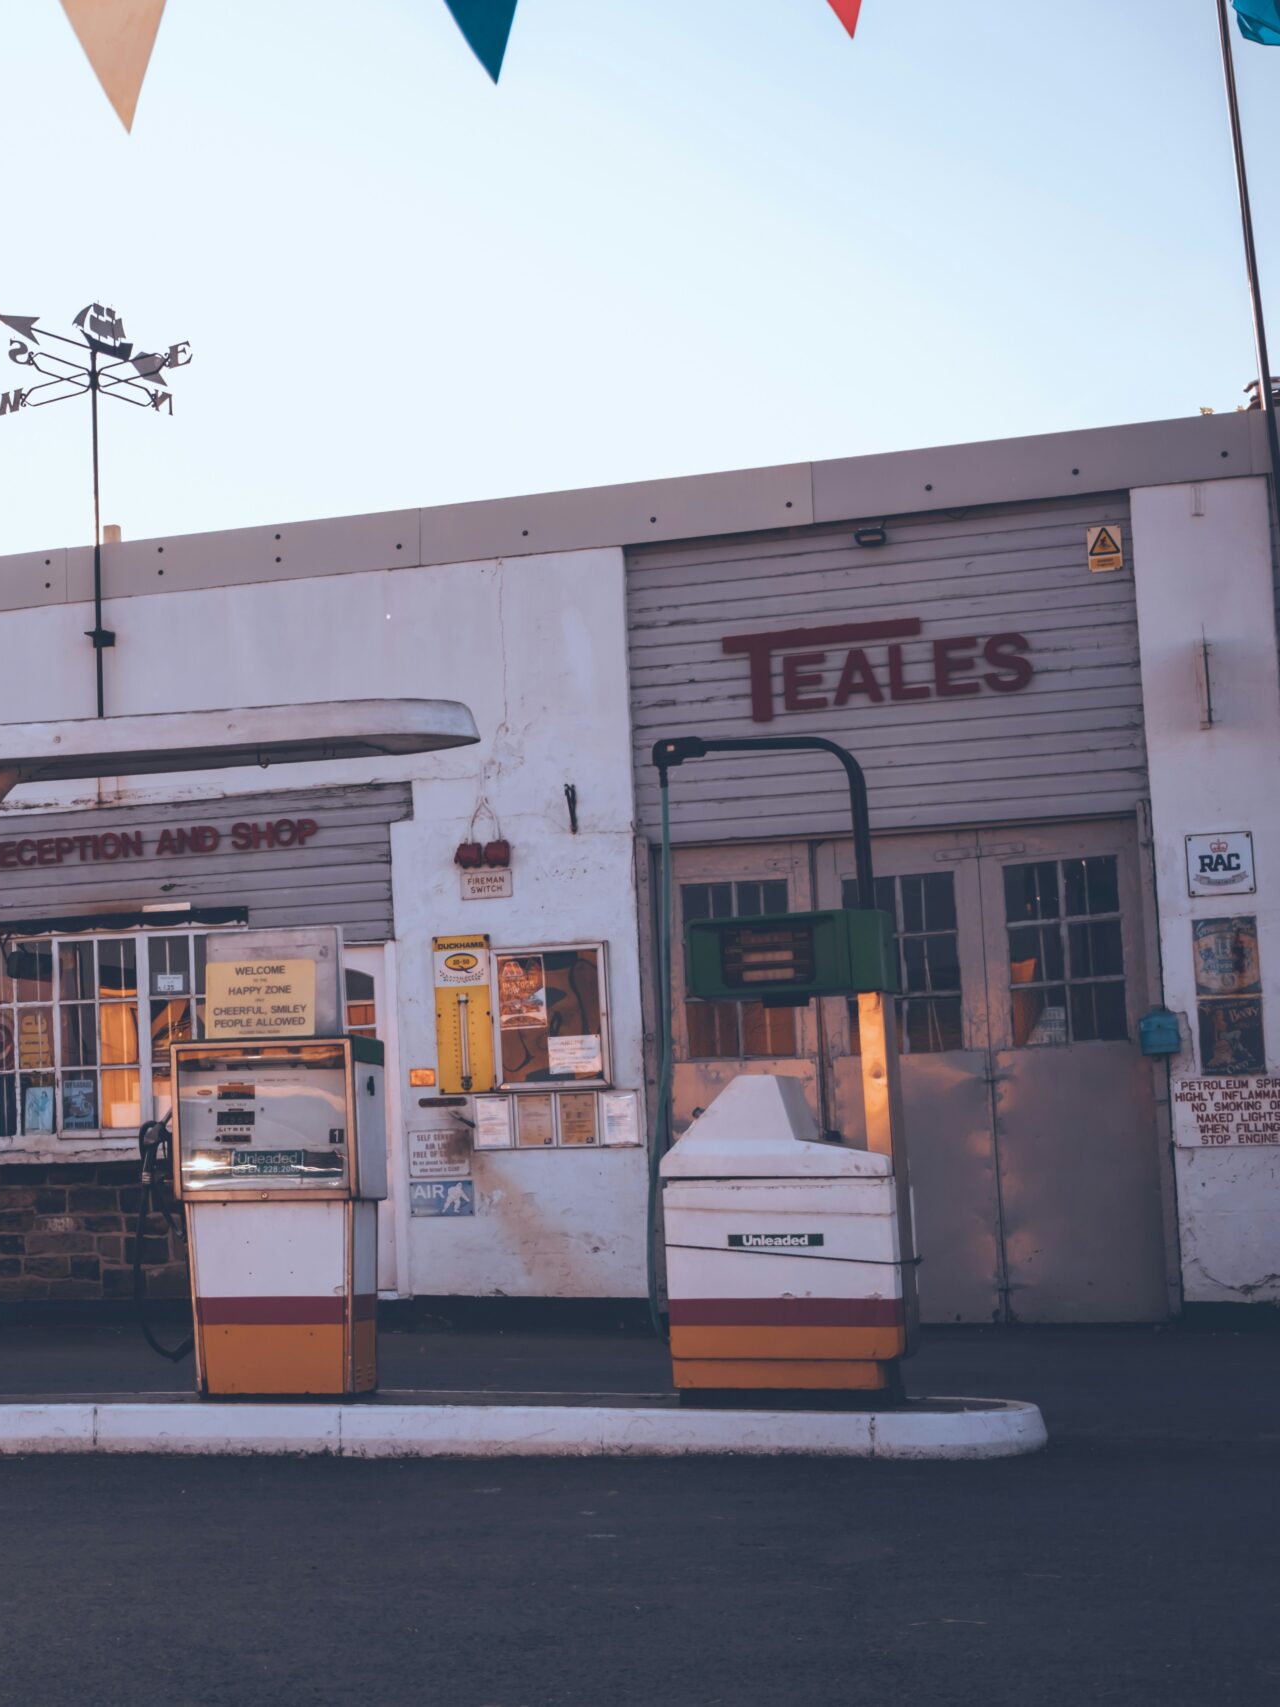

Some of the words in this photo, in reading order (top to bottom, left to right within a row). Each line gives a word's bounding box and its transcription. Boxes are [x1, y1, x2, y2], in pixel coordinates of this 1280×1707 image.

[168, 341, 193, 369] E
[156, 825, 220, 855] AND
[231, 818, 319, 851] SHOP
[1198, 852, 1241, 873] RAC
[467, 876, 505, 886] FIREMAN
[470, 885, 503, 894] SWITCH
[437, 941, 484, 950] DUCKHAMS
[234, 965, 286, 976] WELCOME
[228, 986, 262, 996] HAPPY
[264, 985, 292, 995] ZONE
[213, 1006, 268, 1016] CHEERFUL,
[270, 1004, 308, 1014] SMILEY
[214, 1018, 252, 1028] PEOPLE
[255, 1016, 306, 1027] ALLOWED
[1181, 1080, 1249, 1091] PETROLEUM
[1175, 1091, 1215, 1102] HIGHLY
[1221, 1090, 1280, 1101] INFLAMMA
[1191, 1102, 1207, 1112] NO
[1214, 1101, 1262, 1112] SMOKING
[1196, 1113, 1234, 1123] NAKED
[1240, 1112, 1280, 1122] LIGHTS
[1199, 1124, 1230, 1134] WHEN
[1236, 1122, 1280, 1133] FILLING
[333, 1130, 339, 1143] 1
[416, 1134, 431, 1142] SELF
[1201, 1135, 1231, 1145] STOP
[1238, 1133, 1279, 1144] ENGINE
[236, 1152, 298, 1164] Unleaded
[414, 1184, 446, 1199] AIR
[741, 1234, 809, 1246] Unleaded
